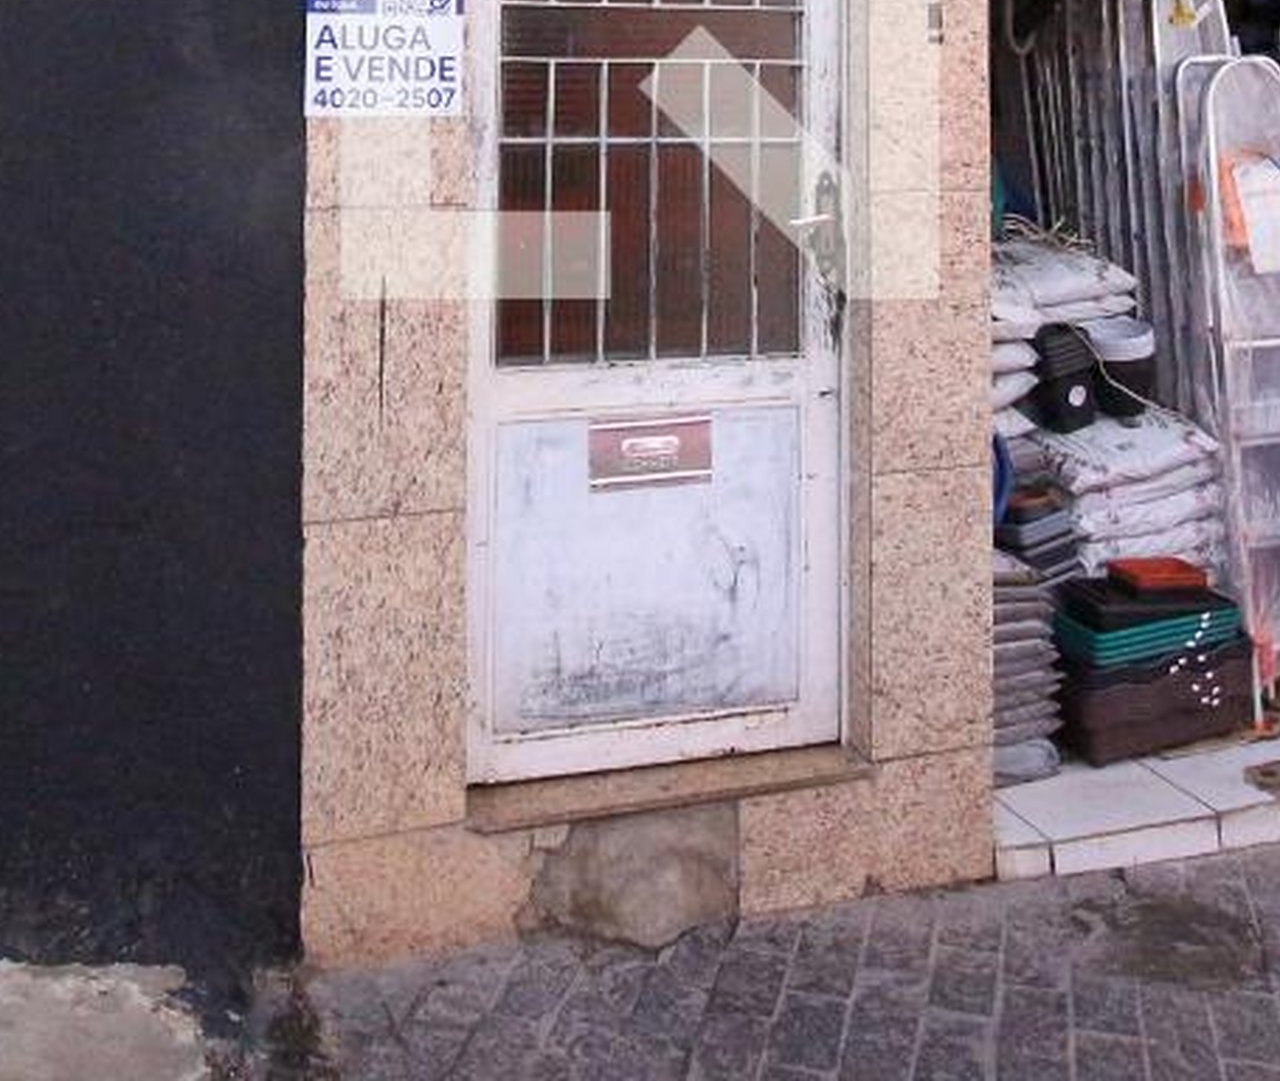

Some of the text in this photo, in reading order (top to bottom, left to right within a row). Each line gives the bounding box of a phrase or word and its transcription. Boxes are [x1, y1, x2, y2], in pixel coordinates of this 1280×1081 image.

[314, 24, 431, 50] ALUGA
[314, 56, 457, 83] E VENDE
[313, 87, 457, 109] 4020-2507
